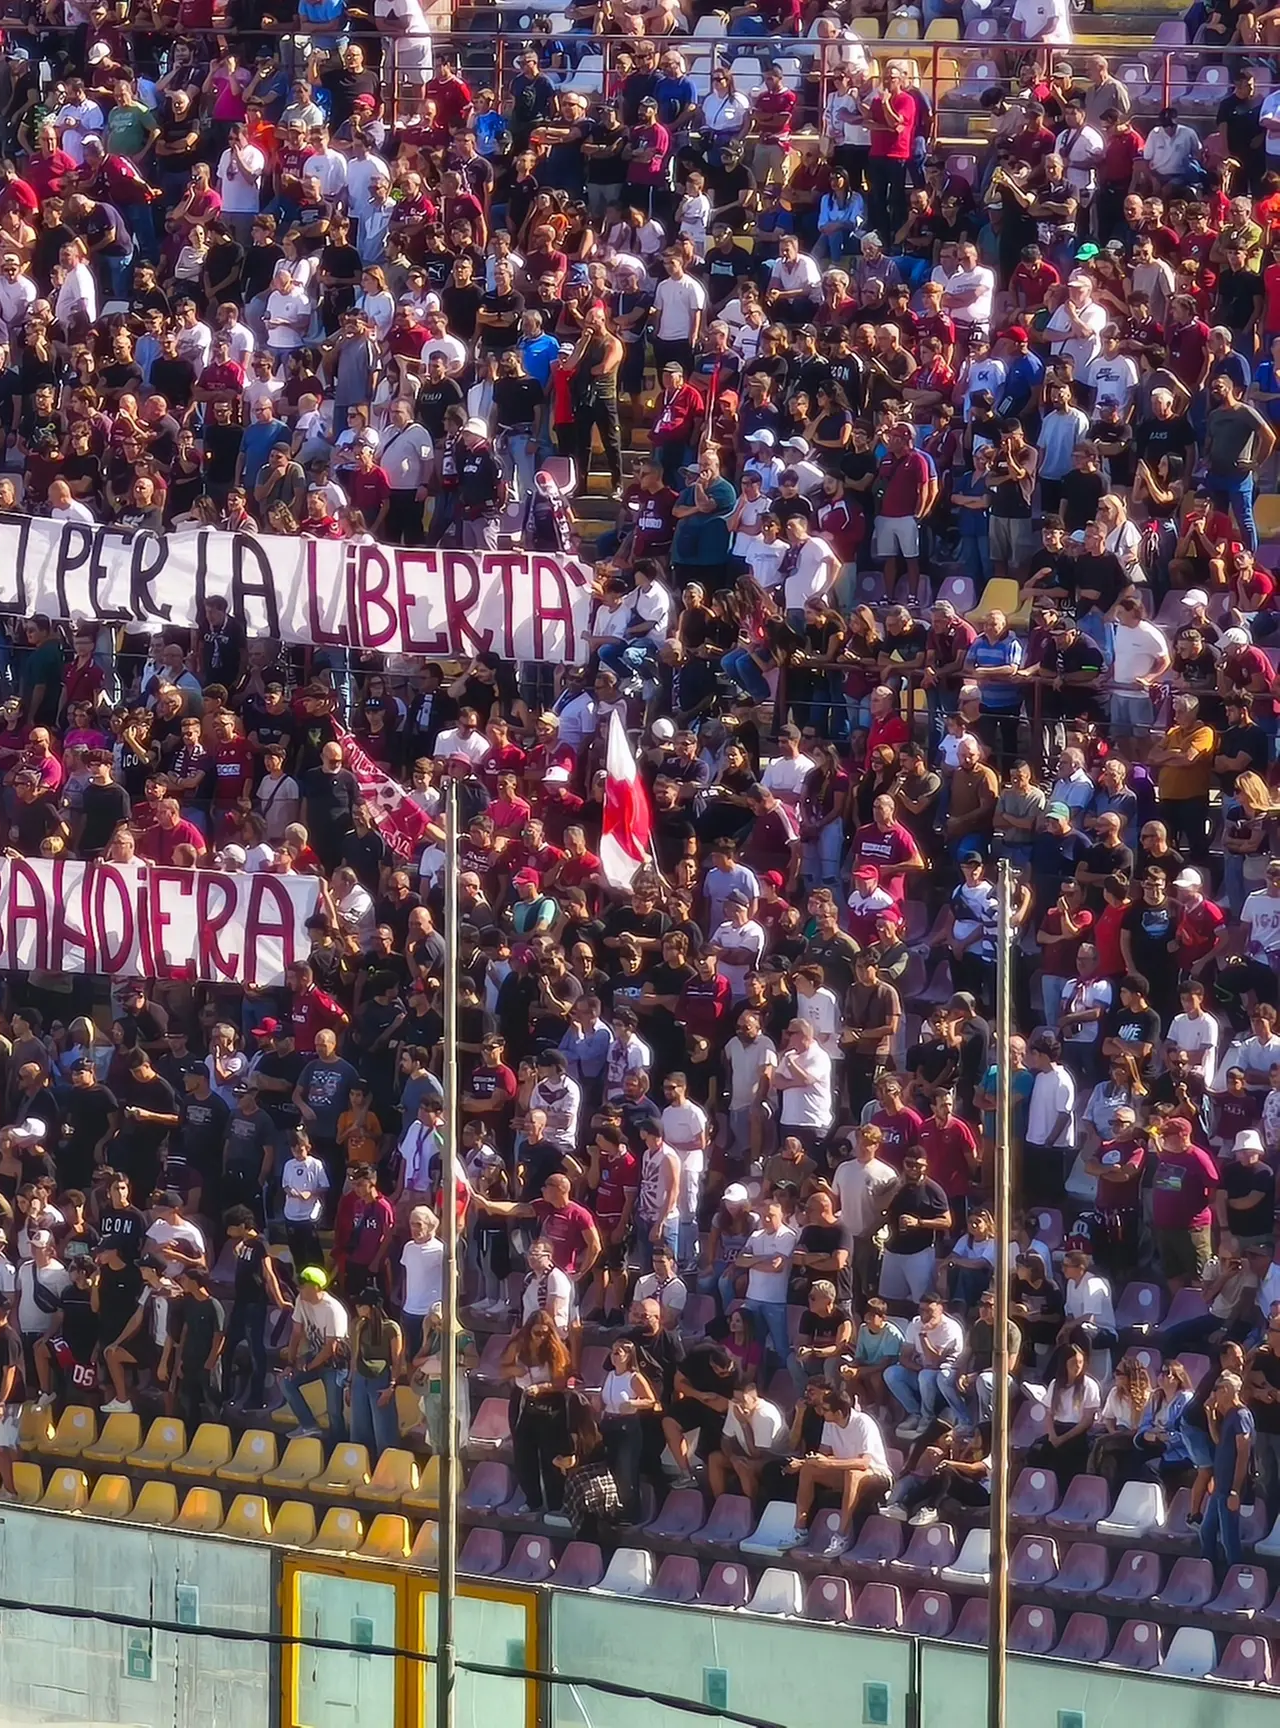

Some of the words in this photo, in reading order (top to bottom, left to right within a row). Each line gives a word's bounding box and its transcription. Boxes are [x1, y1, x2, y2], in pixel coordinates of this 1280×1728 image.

[55, 524, 171, 621] PER
[122, 754, 143, 769] ICO
[100, 1217, 134, 1235] ICON
